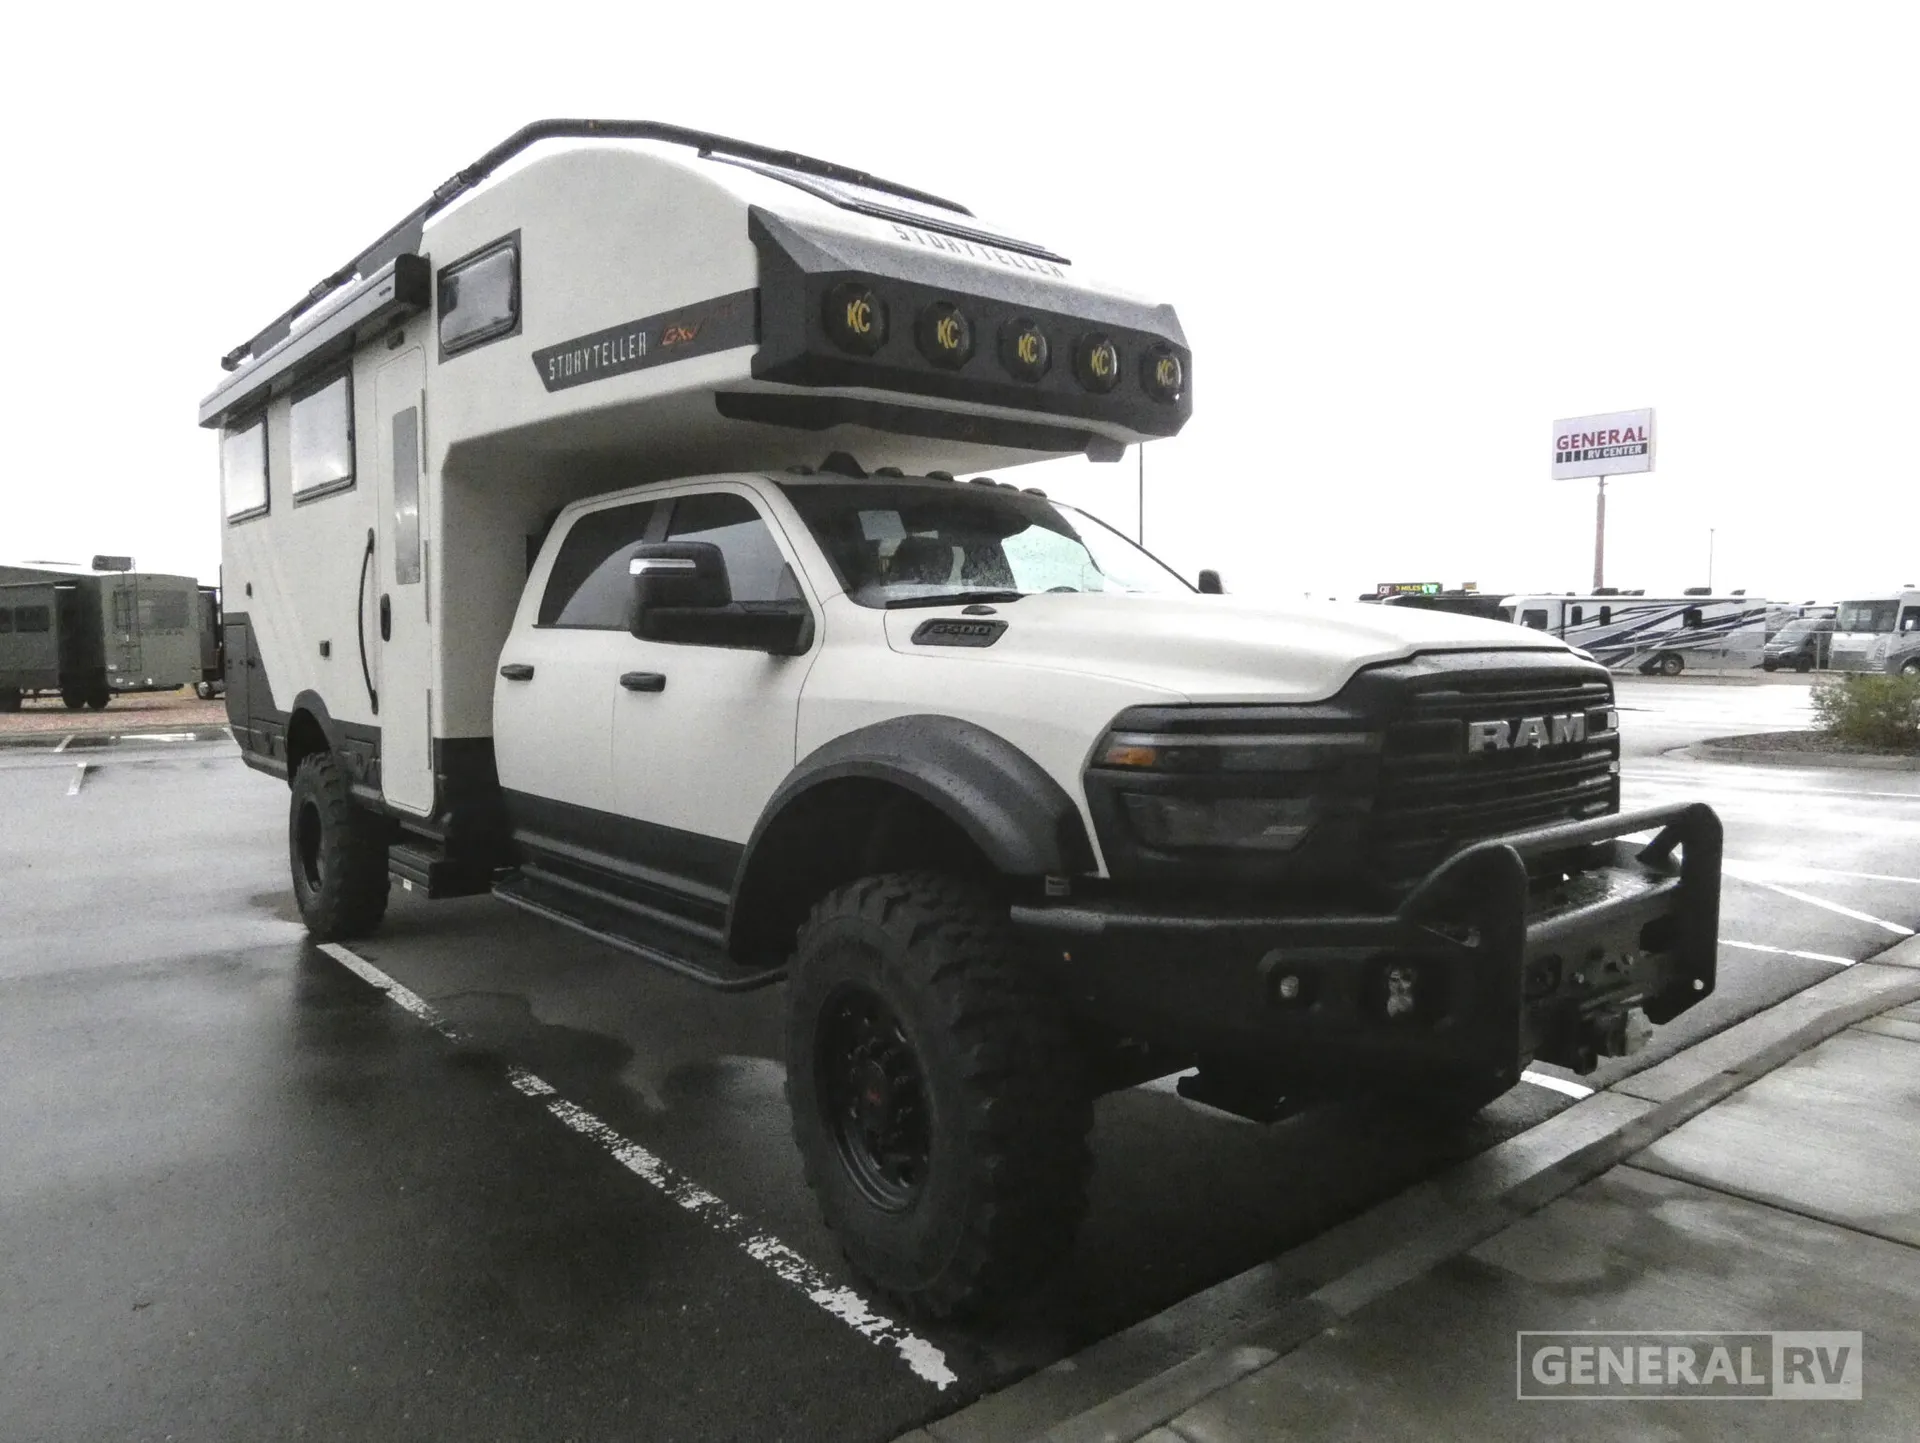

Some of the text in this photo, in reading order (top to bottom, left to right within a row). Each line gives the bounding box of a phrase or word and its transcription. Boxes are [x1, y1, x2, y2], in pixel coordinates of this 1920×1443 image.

[847, 299, 870, 334] KC
[937, 316, 959, 349] KC
[549, 331, 647, 381] STORYTELLER
[1018, 332, 1037, 364] KC
[1091, 345, 1109, 377] KC
[1156, 358, 1174, 387] KC
[1556, 426, 1648, 451] GENERAL
[1587, 444, 1642, 459] RV CENTER
[1468, 712, 1585, 753] RAM
